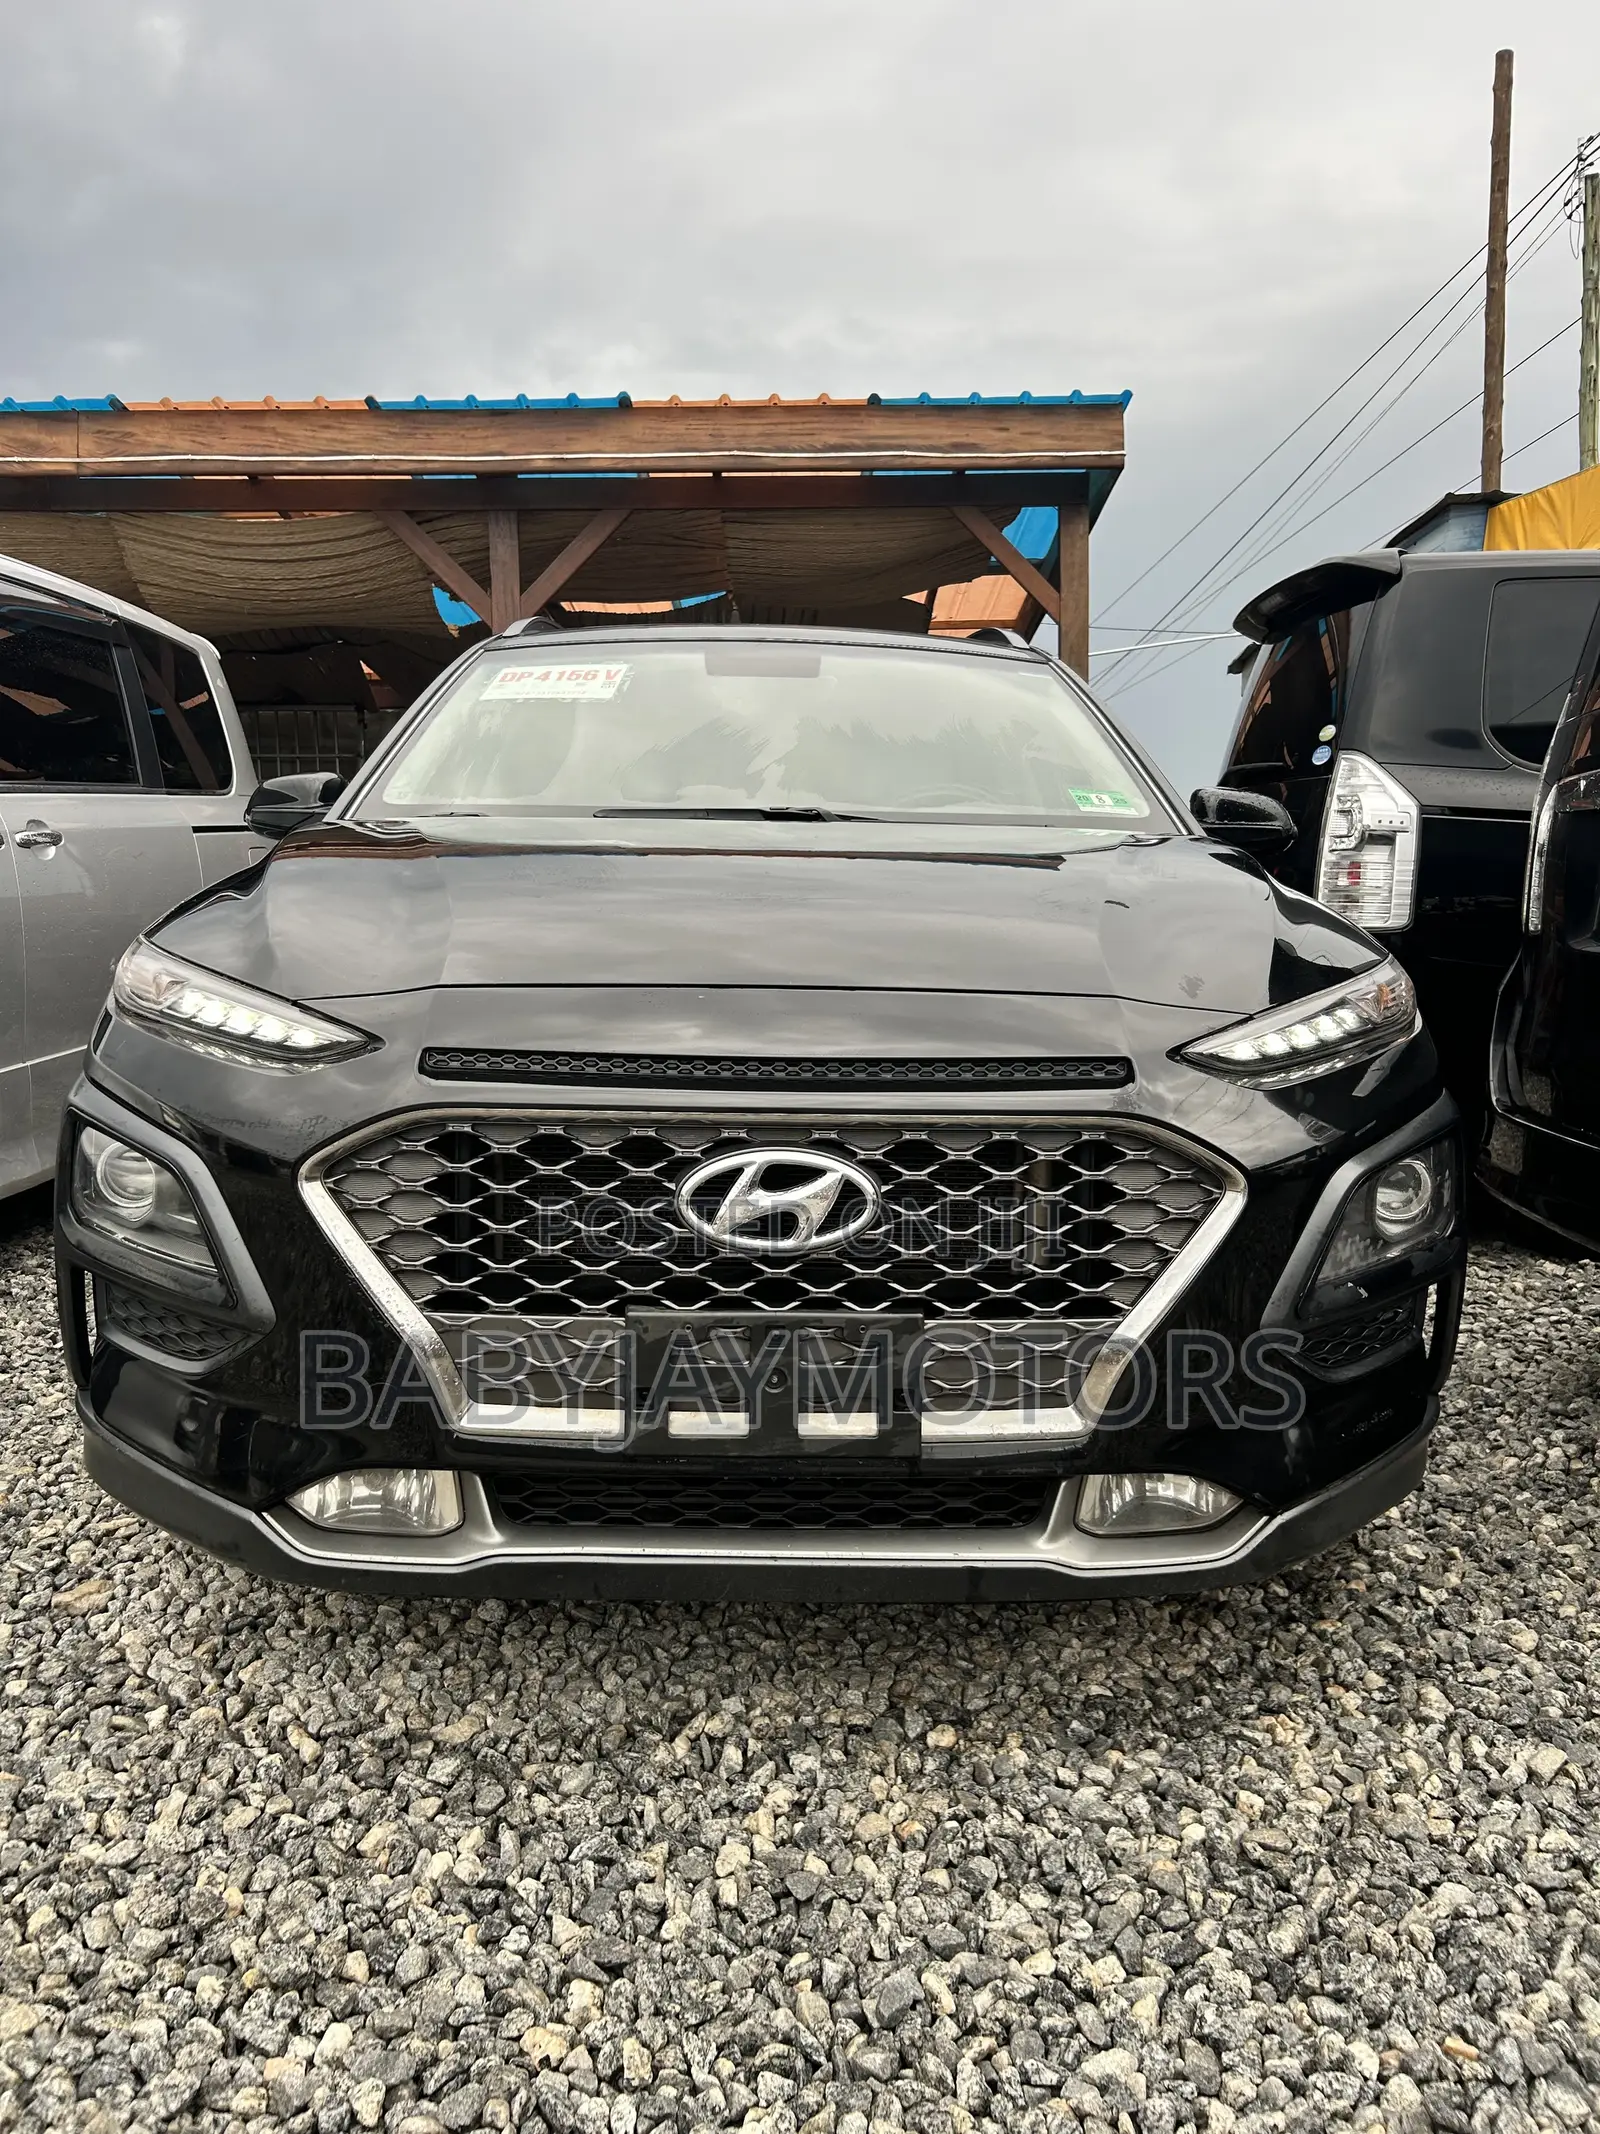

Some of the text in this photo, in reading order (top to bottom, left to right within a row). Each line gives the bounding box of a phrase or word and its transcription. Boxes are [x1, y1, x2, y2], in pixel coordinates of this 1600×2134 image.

[499, 668, 622, 683] DP 4156 V
